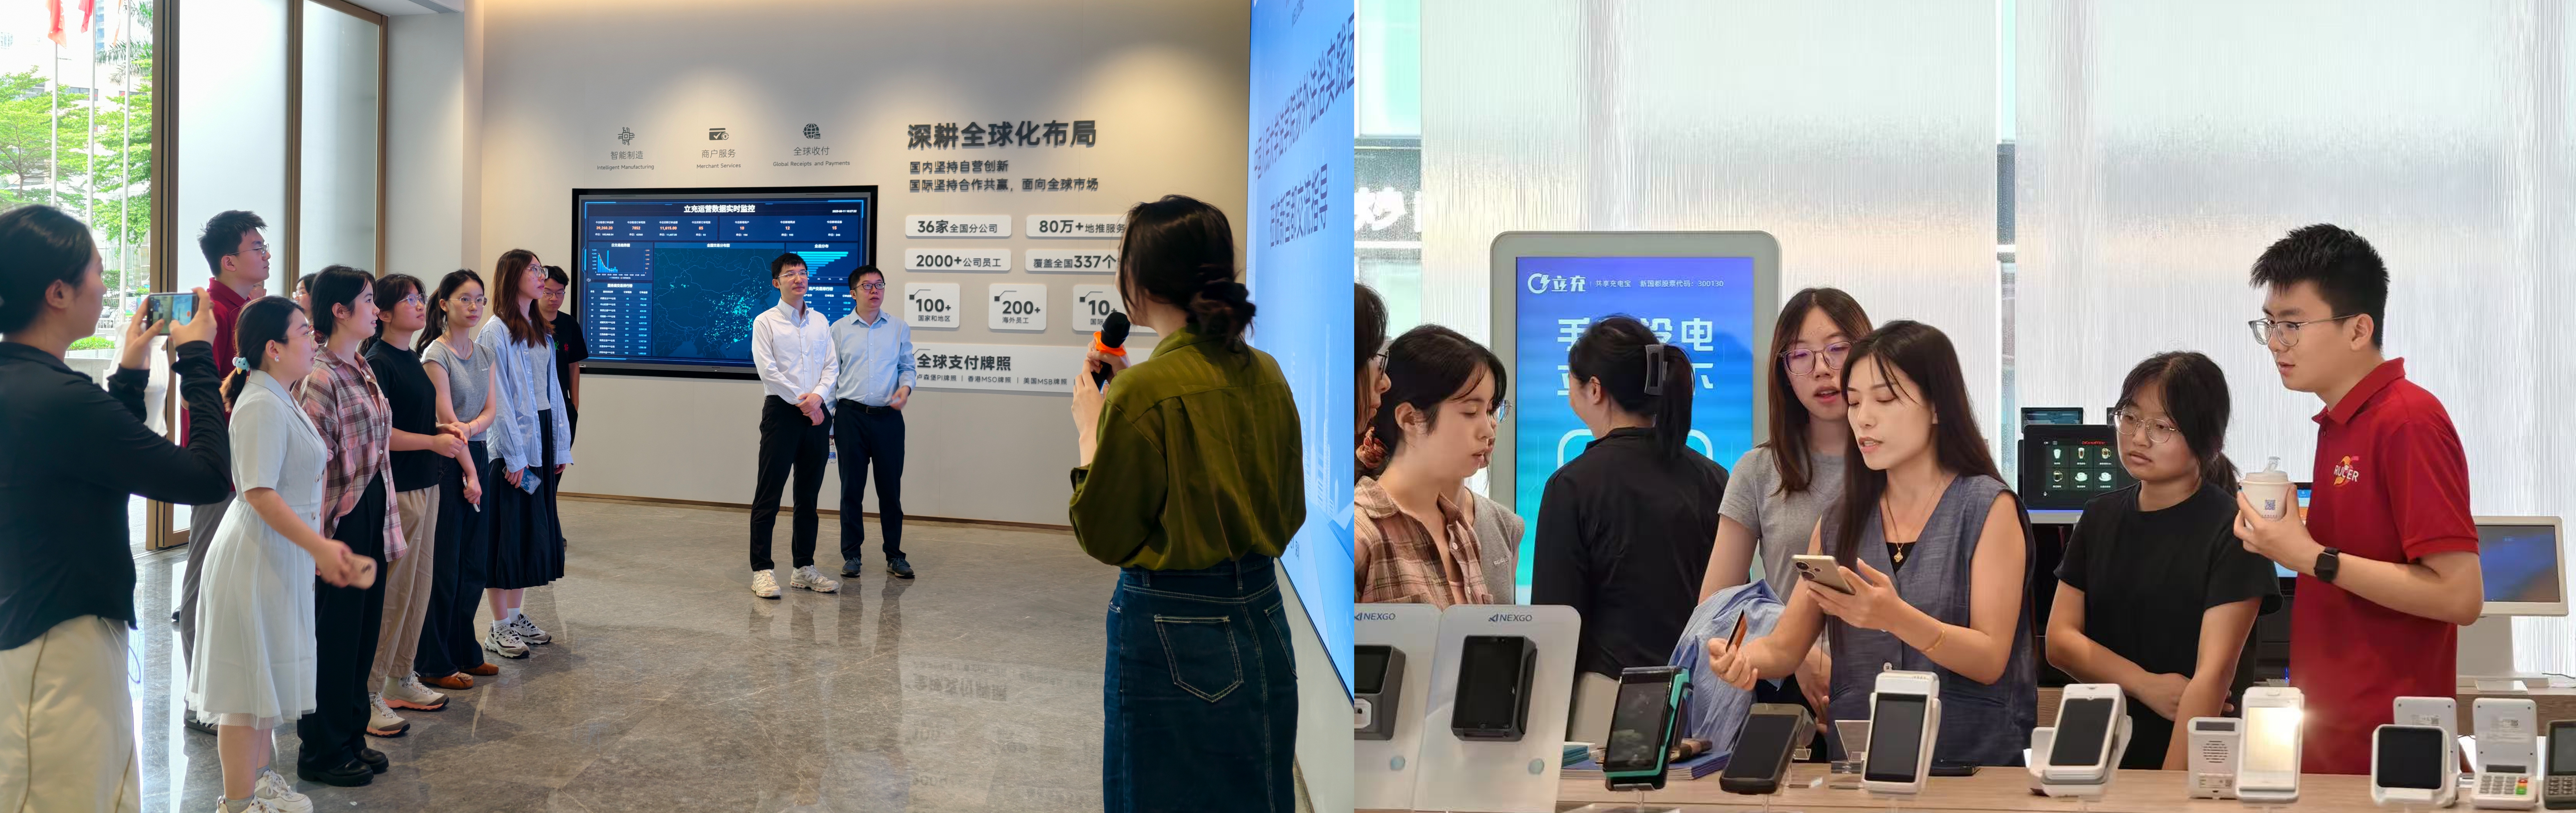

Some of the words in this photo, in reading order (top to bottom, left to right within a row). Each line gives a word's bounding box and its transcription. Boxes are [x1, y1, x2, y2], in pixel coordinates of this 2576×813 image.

[1254, 12, 1354, 184] 中国人民大学法学院涉外法治实践团
[907, 119, 1097, 149] 深耕全球化布局
[611, 151, 643, 160] 智能制造
[701, 149, 736, 158] 商户服务
[793, 146, 829, 156] 全球收付
[910, 160, 1009, 174] 国内坚持自营创新
[910, 178, 1099, 192] 国际坚持合作共赢，面向全球市场
[683, 205, 755, 213] 立充运营数据实时监控
[1270, 163, 1327, 250] 莅临新国都交流指导
[917, 220, 998, 233] 36家全国分公司
[1039, 220, 1126, 233] 80万+地推服务
[916, 254, 1001, 267] 2000+公司员工
[1033, 254, 1117, 269] 覆盖全国337个
[1551, 275, 1586, 292] 立充
[916, 299, 951, 312] 100+
[1002, 301, 1040, 314] 200+
[917, 354, 1011, 371] 全球支付牌照
[916, 374, 957, 382] 卢森堡PI牌照
[968, 375, 1011, 383] 香港MSO牌照
[2333, 465, 2359, 482] RUCER
